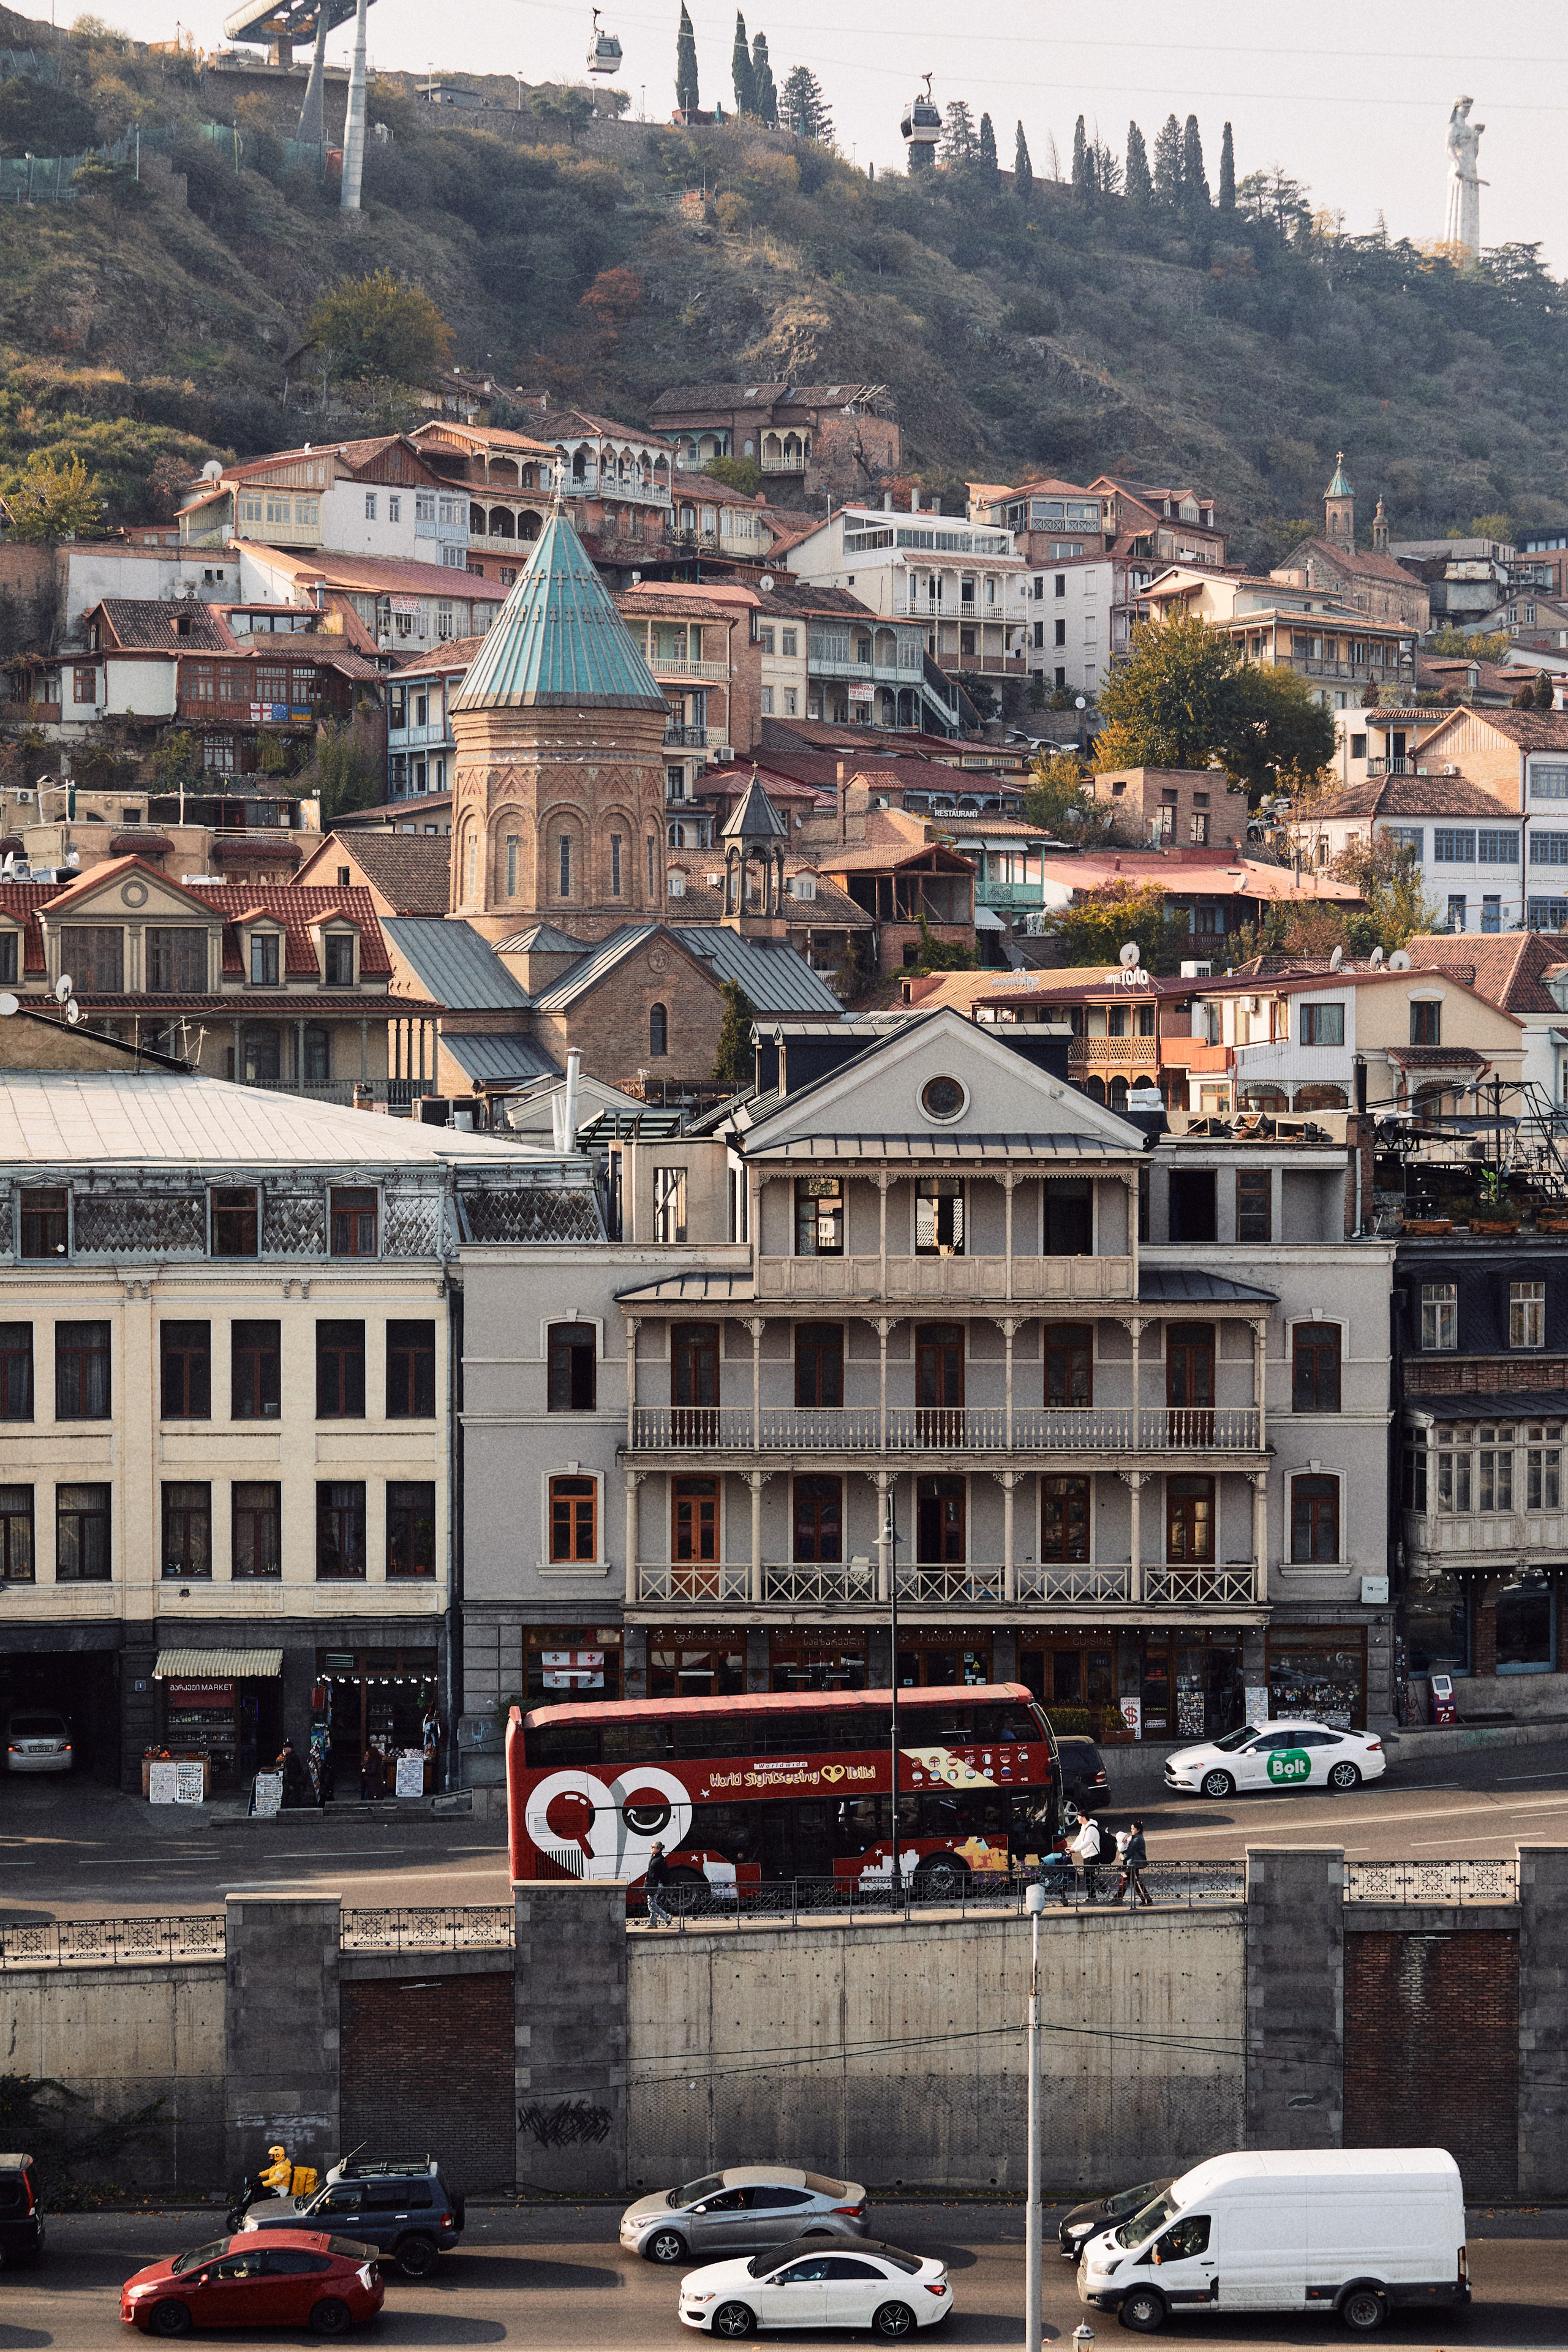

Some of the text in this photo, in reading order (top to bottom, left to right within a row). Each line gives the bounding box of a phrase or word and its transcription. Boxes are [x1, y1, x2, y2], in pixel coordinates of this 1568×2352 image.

[1105, 974, 1121, 984] HOTEL
[919, 1629, 987, 1642] Pasanauri
[1040, 1627, 1095, 1635] GEORGAN
[1072, 1637, 1113, 1646] CUISINE
[1272, 1758, 1306, 1776] Bolt
[710, 1765, 876, 1787] World Sightseeing Tbilisi
